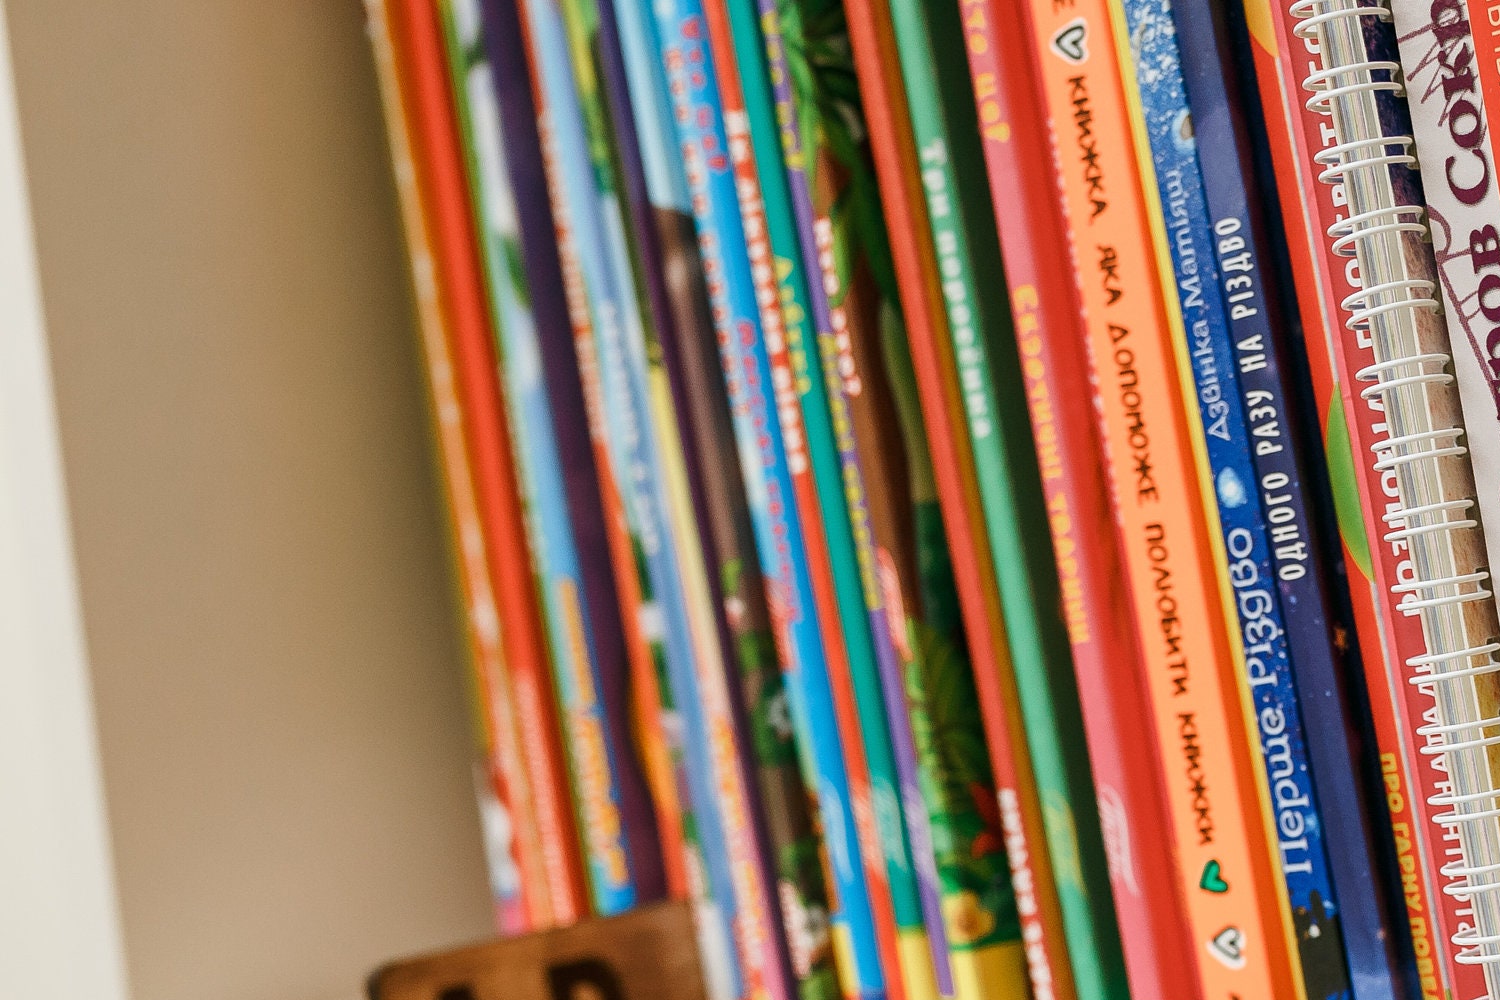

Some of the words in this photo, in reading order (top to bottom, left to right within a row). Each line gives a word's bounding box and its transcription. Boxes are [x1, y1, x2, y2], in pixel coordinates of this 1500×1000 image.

[920, 140, 952, 219] Три
[1096, 243, 1123, 307] ЯКА
[1213, 216, 1260, 318] РІЗДВО
[1185, 317, 1233, 443] Дзвінка
[1239, 332, 1269, 374] НА
[1107, 322, 1160, 502] ДОПОМОЖЕ
[1243, 389, 1284, 456] РАЗУ
[1262, 472, 1308, 582] ОДНОГО
[1145, 523, 1190, 697] ПОЛЮБИТИ
[1226, 526, 1286, 690] Різдво
[1177, 712, 1215, 847] КНИЖКИ
[1252, 709, 1314, 876] Перше
[1379, 751, 1405, 812] ПРО
